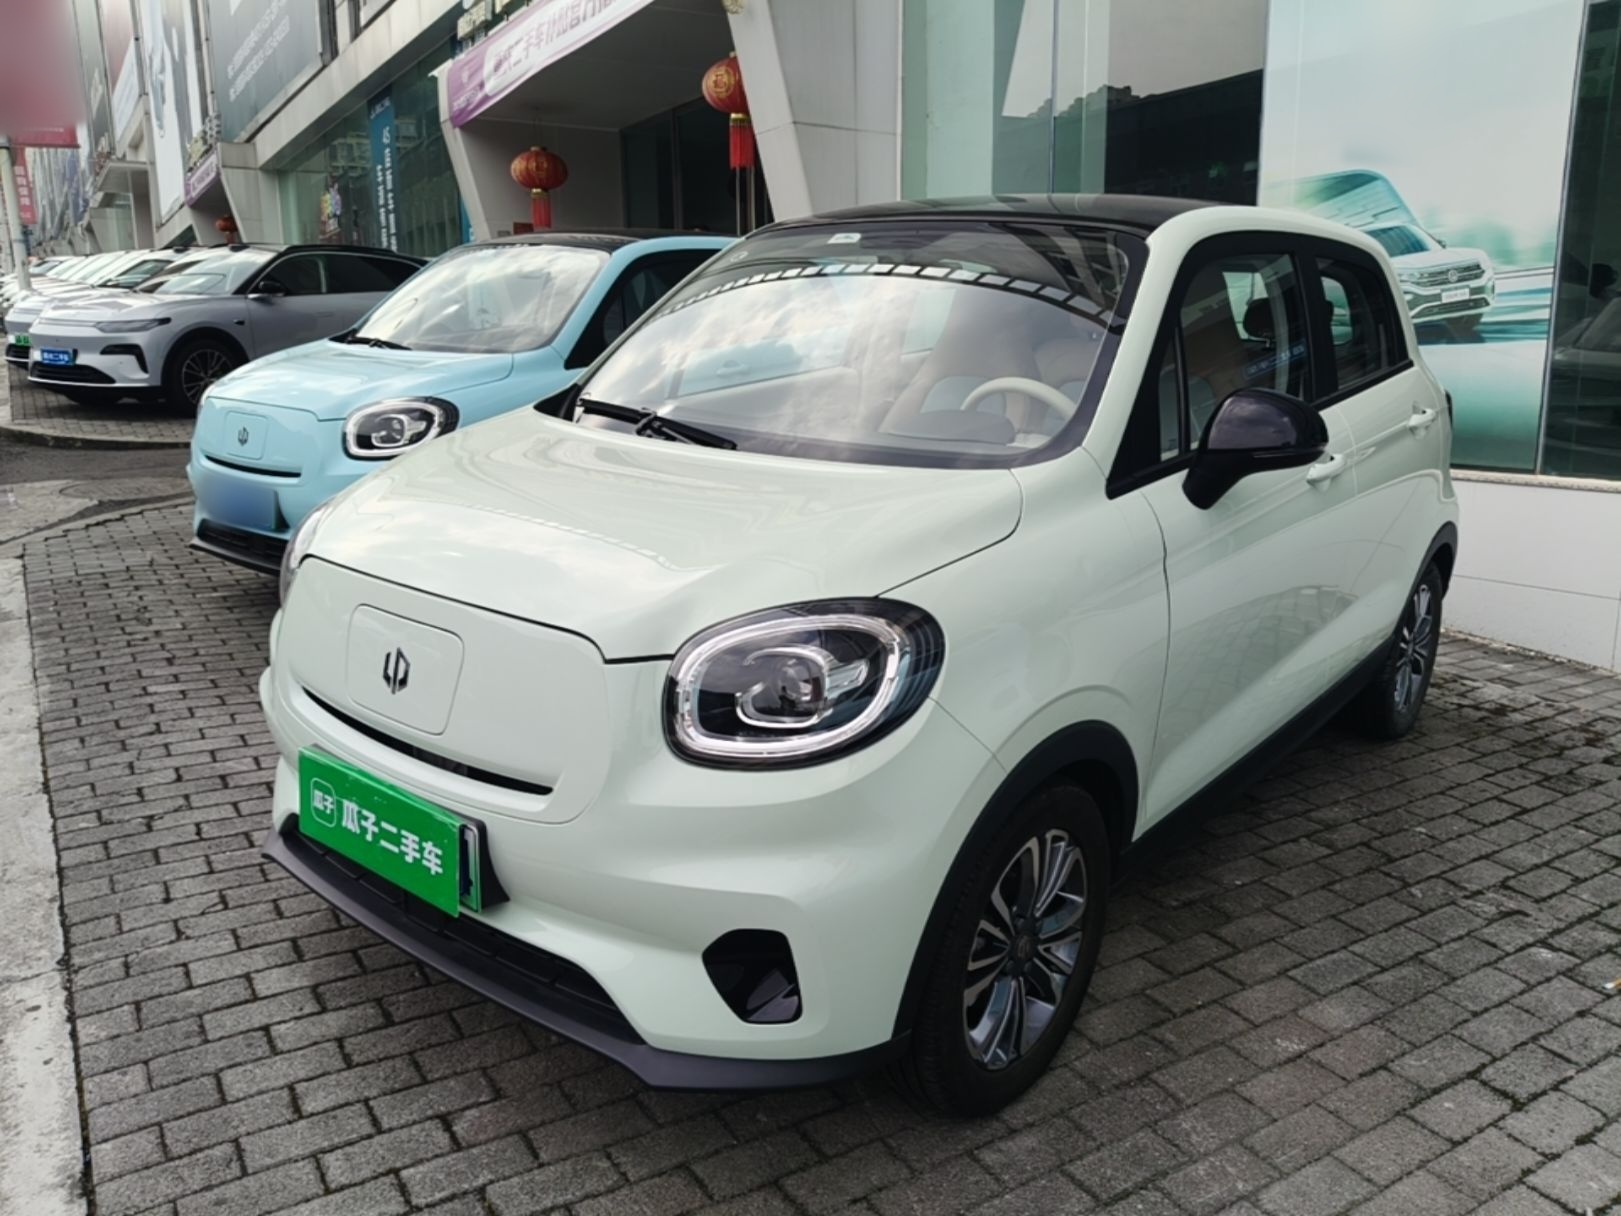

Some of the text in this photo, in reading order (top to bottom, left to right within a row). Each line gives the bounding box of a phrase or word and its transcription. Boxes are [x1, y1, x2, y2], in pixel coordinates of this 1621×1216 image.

[342, 799, 443, 876] 瓜子二手车
